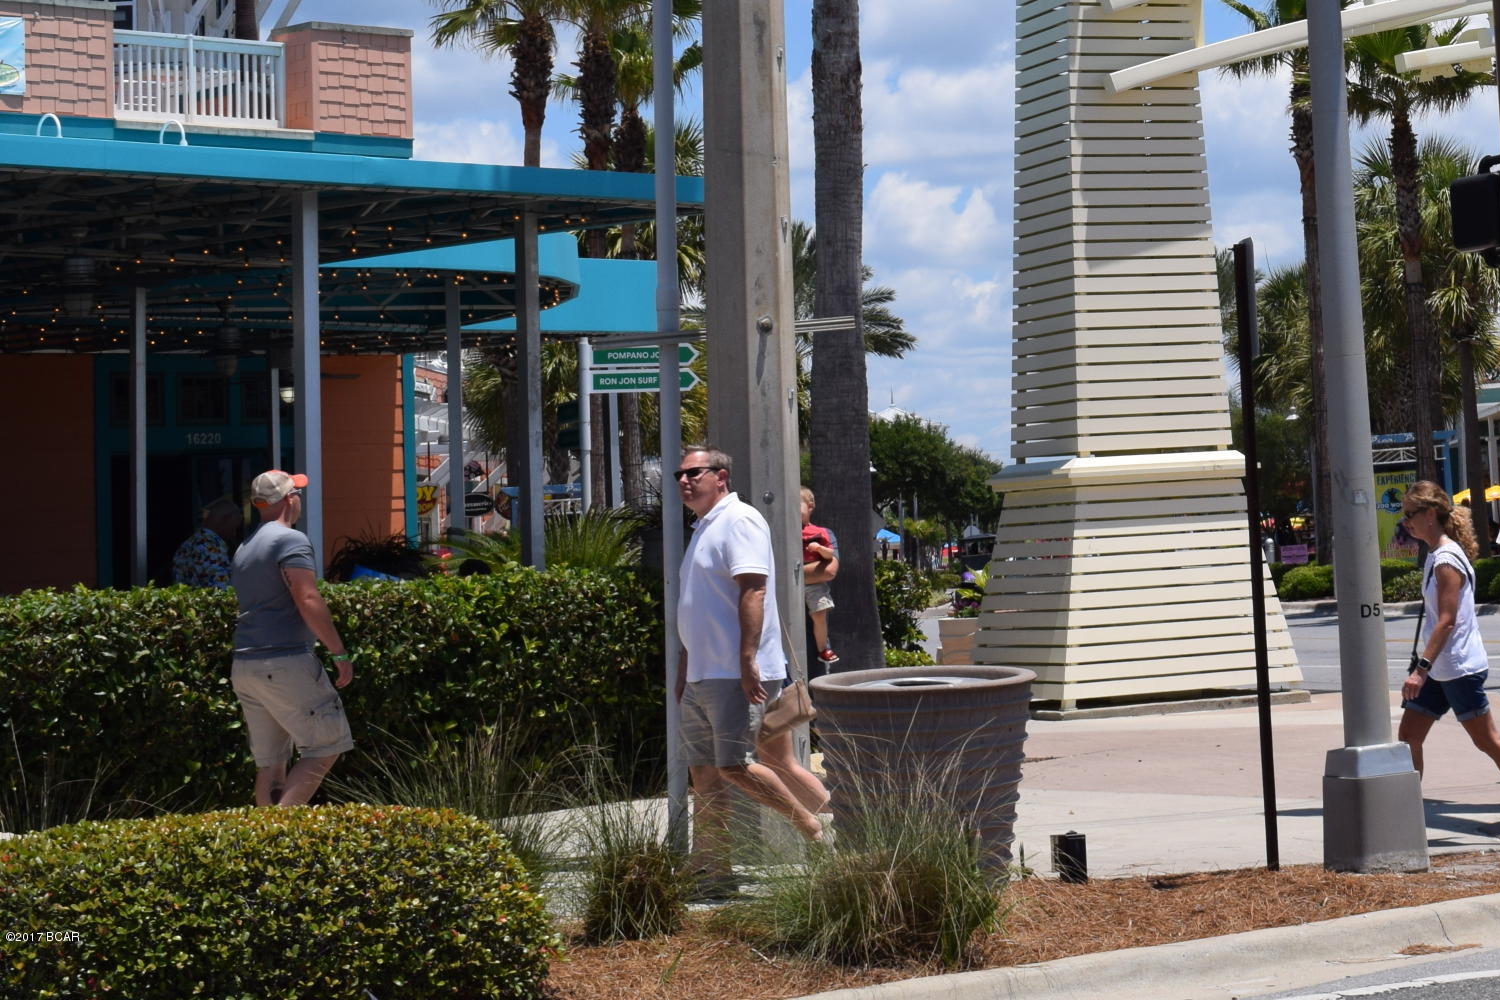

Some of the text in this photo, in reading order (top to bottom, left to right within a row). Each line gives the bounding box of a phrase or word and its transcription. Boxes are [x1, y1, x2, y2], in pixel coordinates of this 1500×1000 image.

[607, 351, 649, 360] POMPANO
[619, 377, 636, 385] JON
[638, 376, 657, 384] SURF
[185, 432, 222, 446] 16220
[1360, 603, 1380, 618] D5
